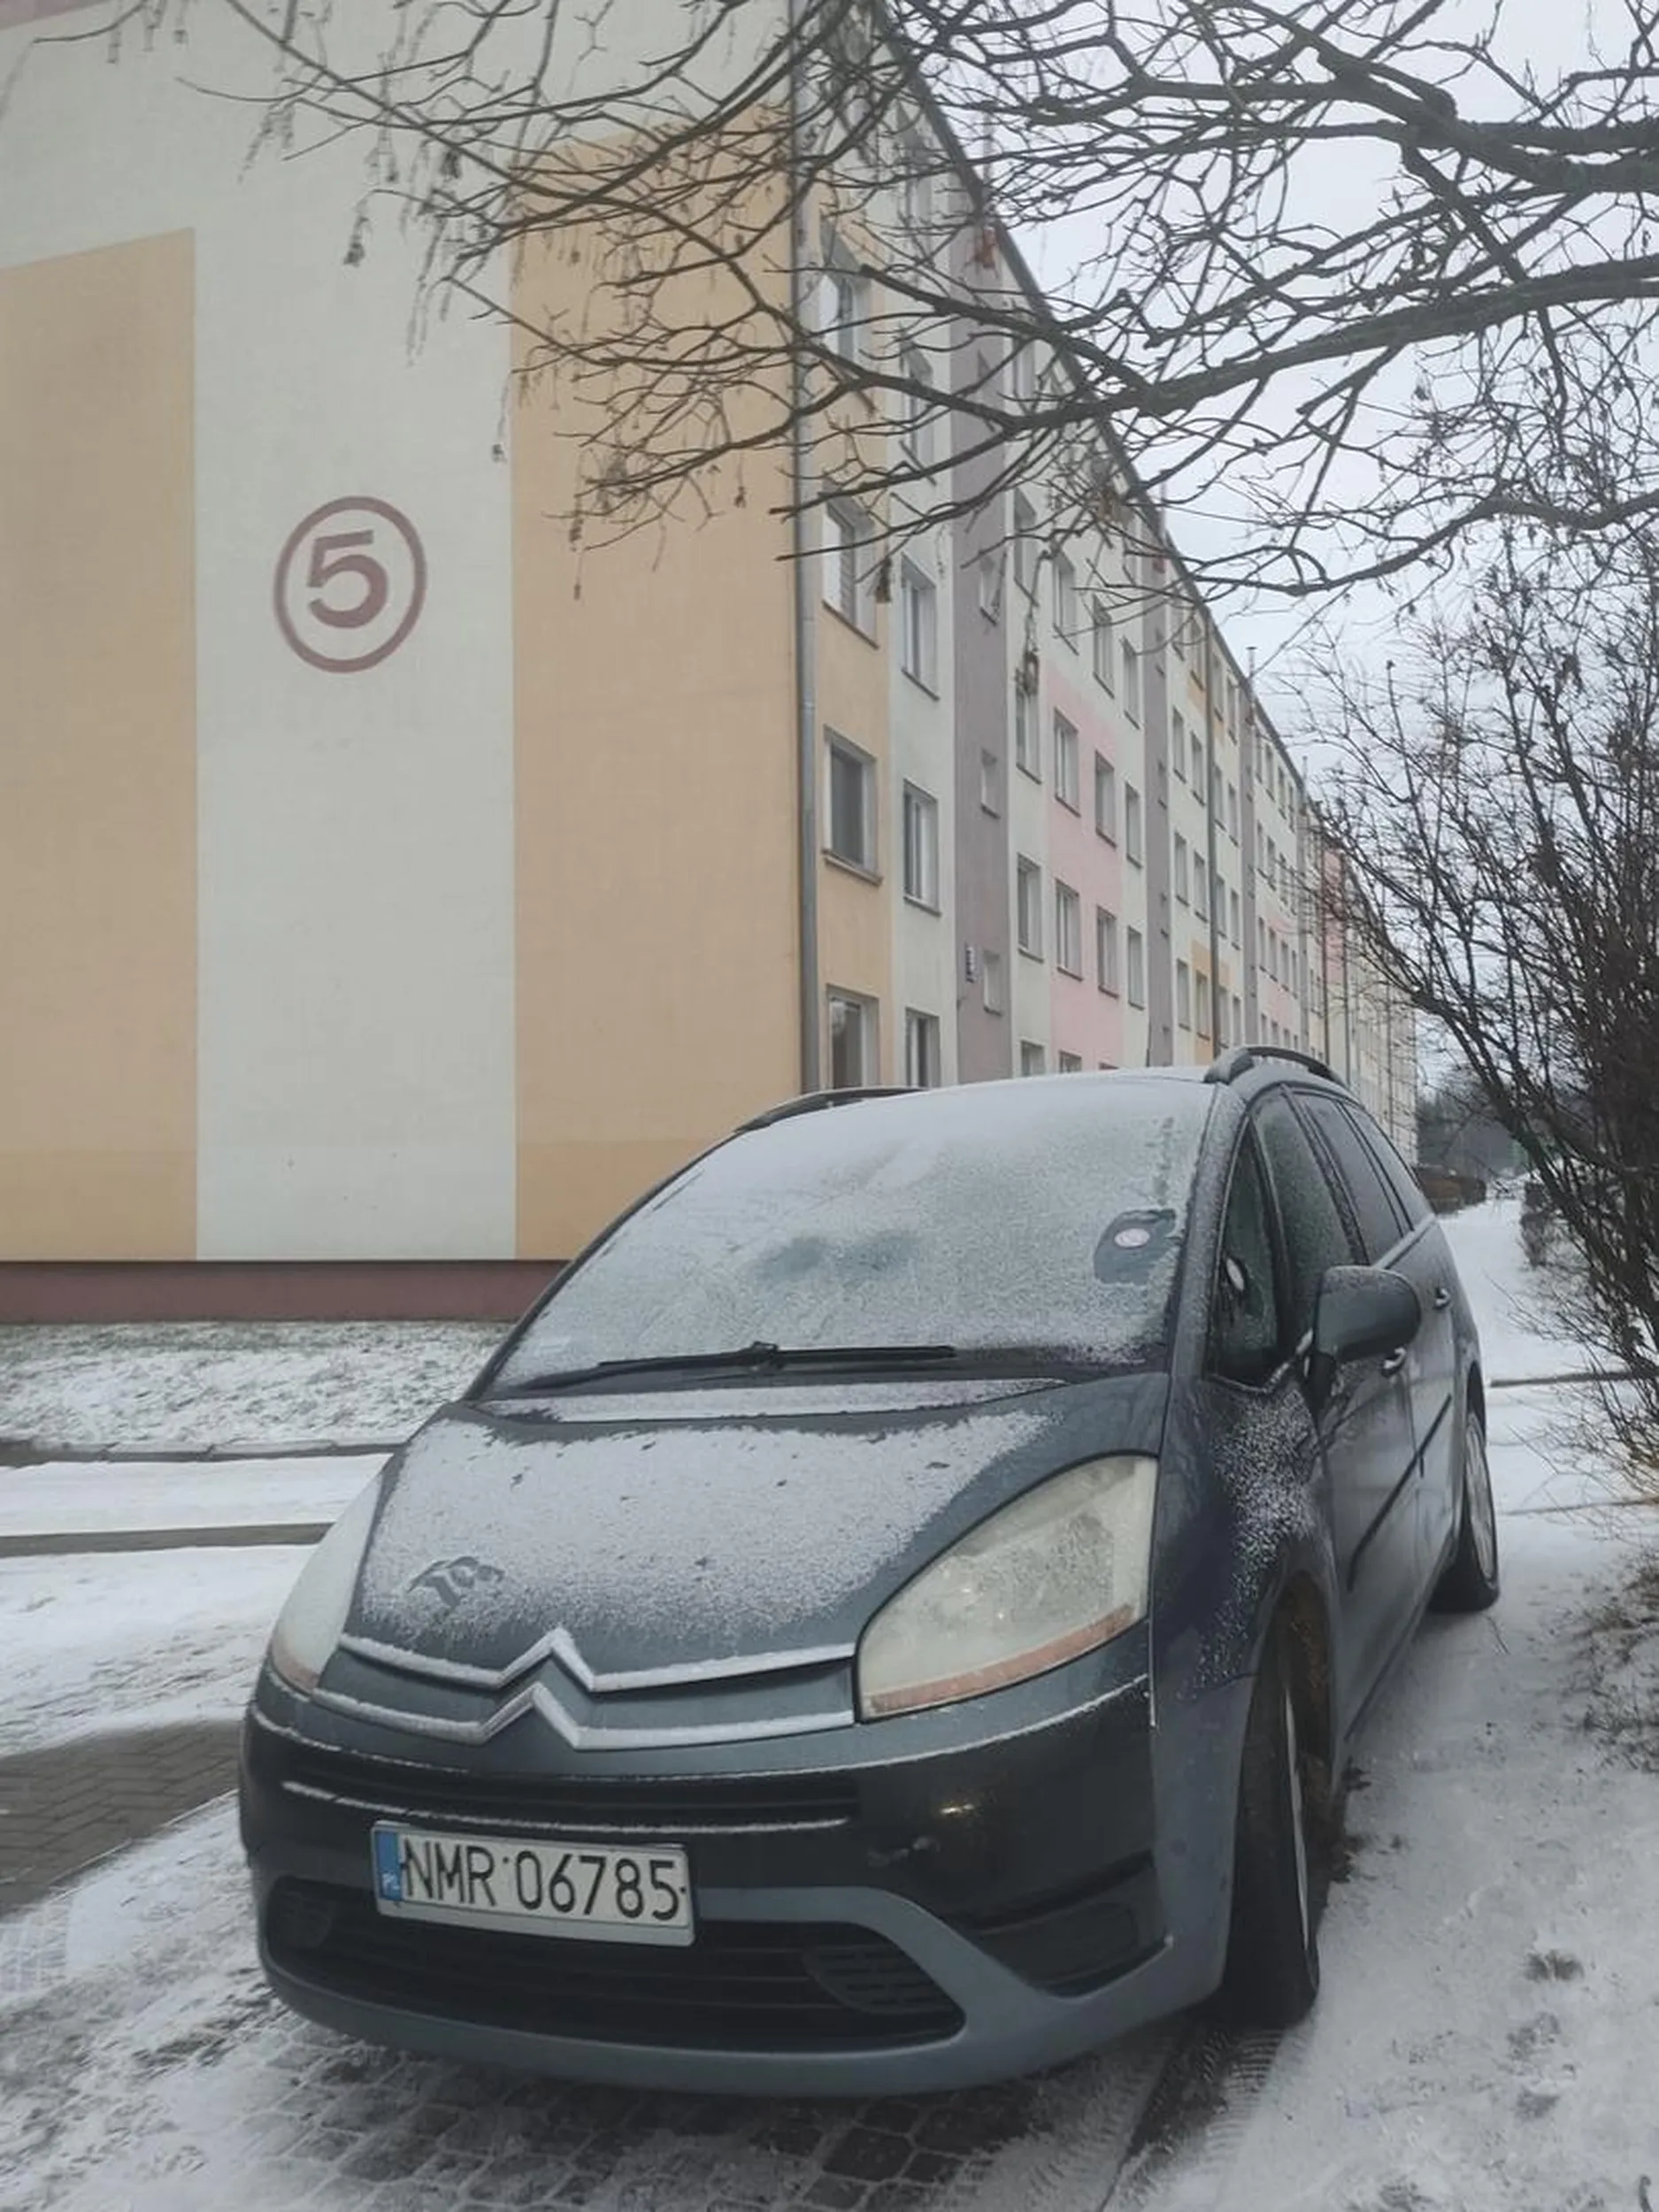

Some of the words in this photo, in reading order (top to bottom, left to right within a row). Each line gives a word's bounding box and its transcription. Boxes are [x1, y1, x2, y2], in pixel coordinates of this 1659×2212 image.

[306, 529, 388, 629] 5
[403, 1838, 496, 1907] NMR
[515, 1850, 680, 1921] 06785
